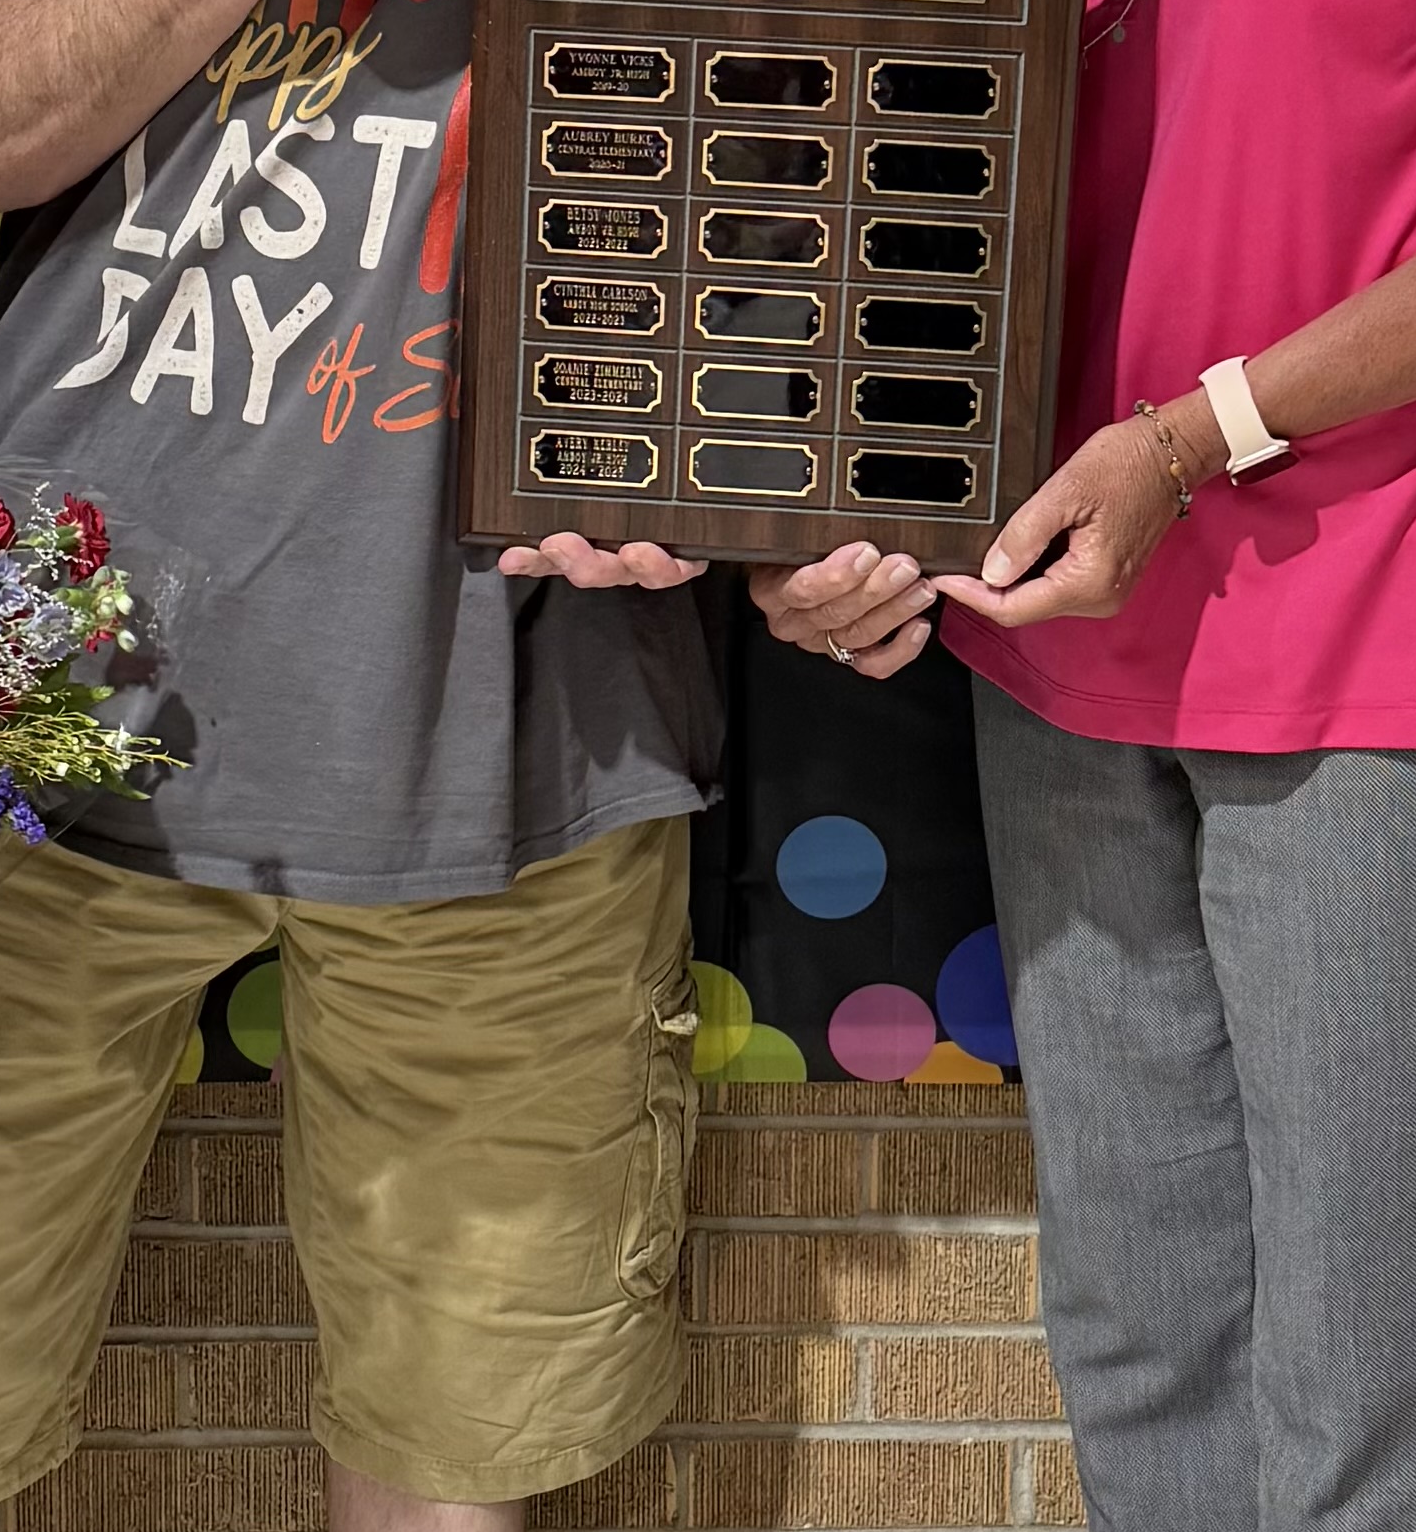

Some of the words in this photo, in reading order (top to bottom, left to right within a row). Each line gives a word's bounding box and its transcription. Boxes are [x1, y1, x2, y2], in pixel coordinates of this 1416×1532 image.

[569, 52, 617, 65] YVONNE
[562, 130, 611, 143] AUBREY
[113, 112, 437, 270] LAST
[553, 284, 597, 298] CYNTHIA
[601, 287, 648, 301] CARLSON
[53, 267, 334, 425] DAY
[306, 323, 377, 445] of
[569, 388, 628, 404] 2023-2024
